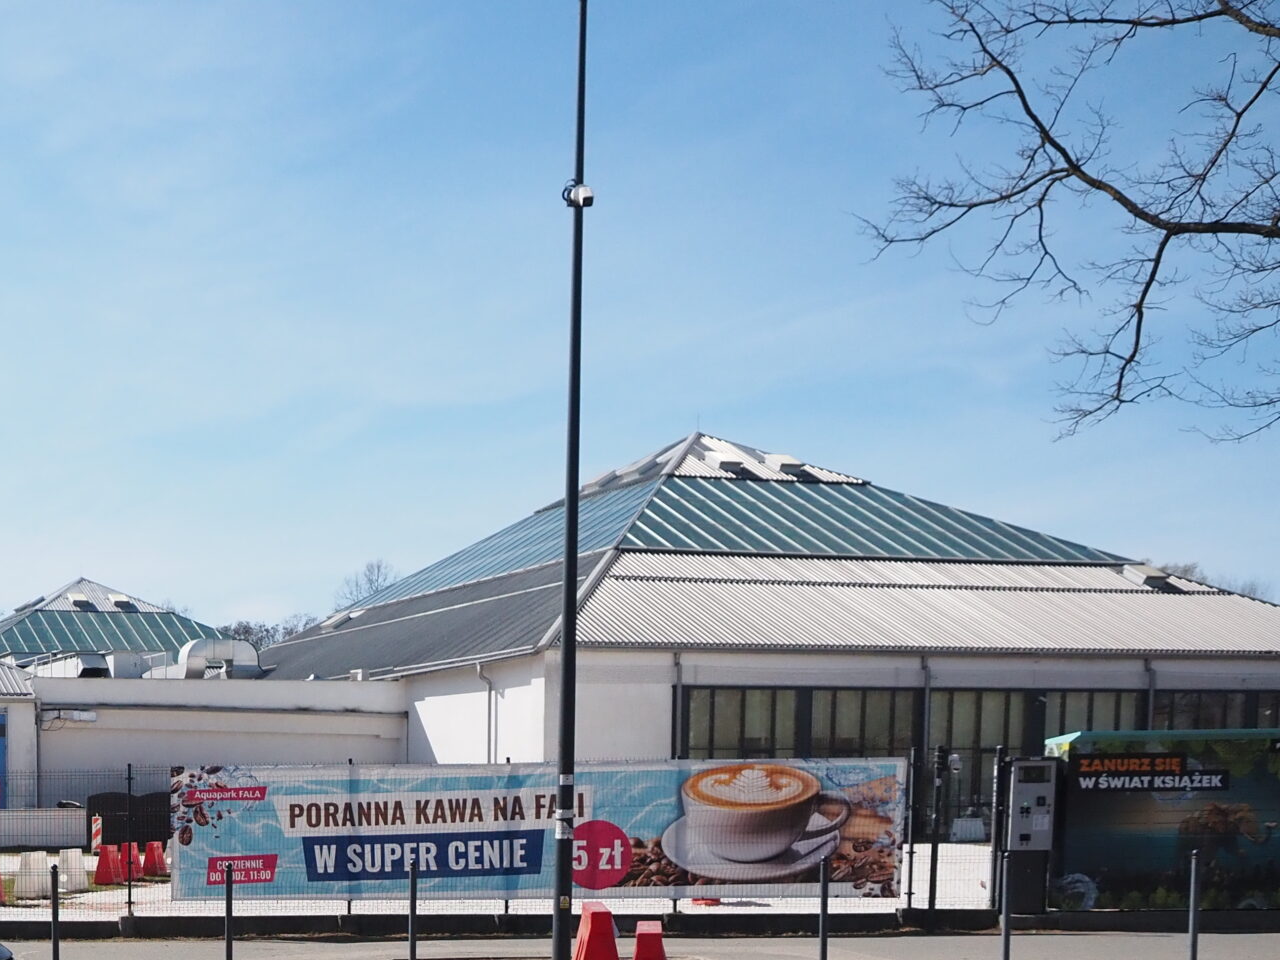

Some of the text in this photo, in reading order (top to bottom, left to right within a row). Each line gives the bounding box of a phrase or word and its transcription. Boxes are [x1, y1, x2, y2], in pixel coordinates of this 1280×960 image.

[1080, 758, 1181, 773] ZANURZ SIĘ
[1079, 773, 1222, 790] W ŚWIAT KSIĄŻEK
[194, 789, 237, 800] Aquapark
[289, 792, 584, 828] PORANNA KAWA NA FAI
[314, 838, 527, 873] W SUPER CENIE
[572, 838, 624, 870] 5 zł
[210, 872, 221, 881] DO
[250, 870, 271, 880] 11:00
